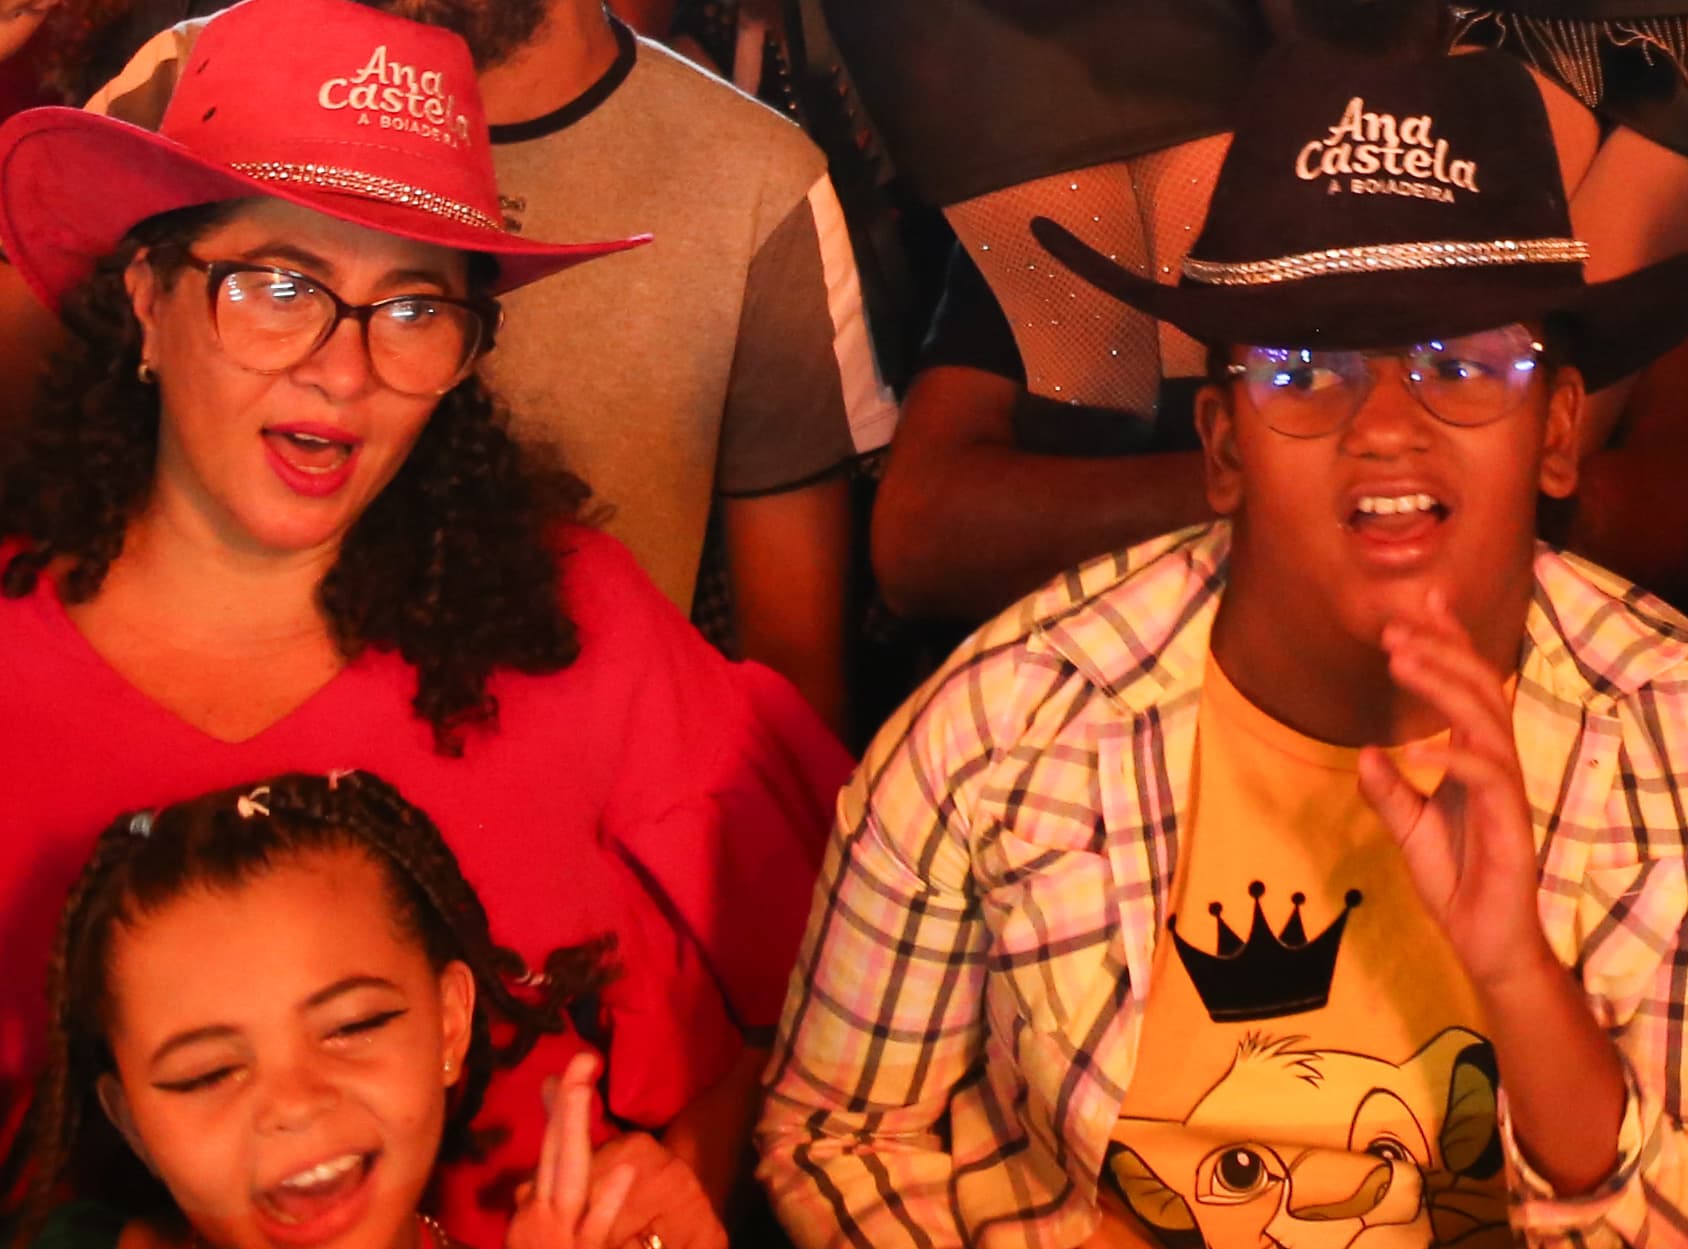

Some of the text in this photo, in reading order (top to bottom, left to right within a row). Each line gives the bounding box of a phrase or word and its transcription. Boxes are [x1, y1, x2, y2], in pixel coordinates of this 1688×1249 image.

[350, 45, 445, 99] Ana
[318, 78, 473, 147] Castela
[357, 113, 371, 126] A
[1323, 96, 1434, 148] Ana
[1295, 138, 1480, 193] Castela
